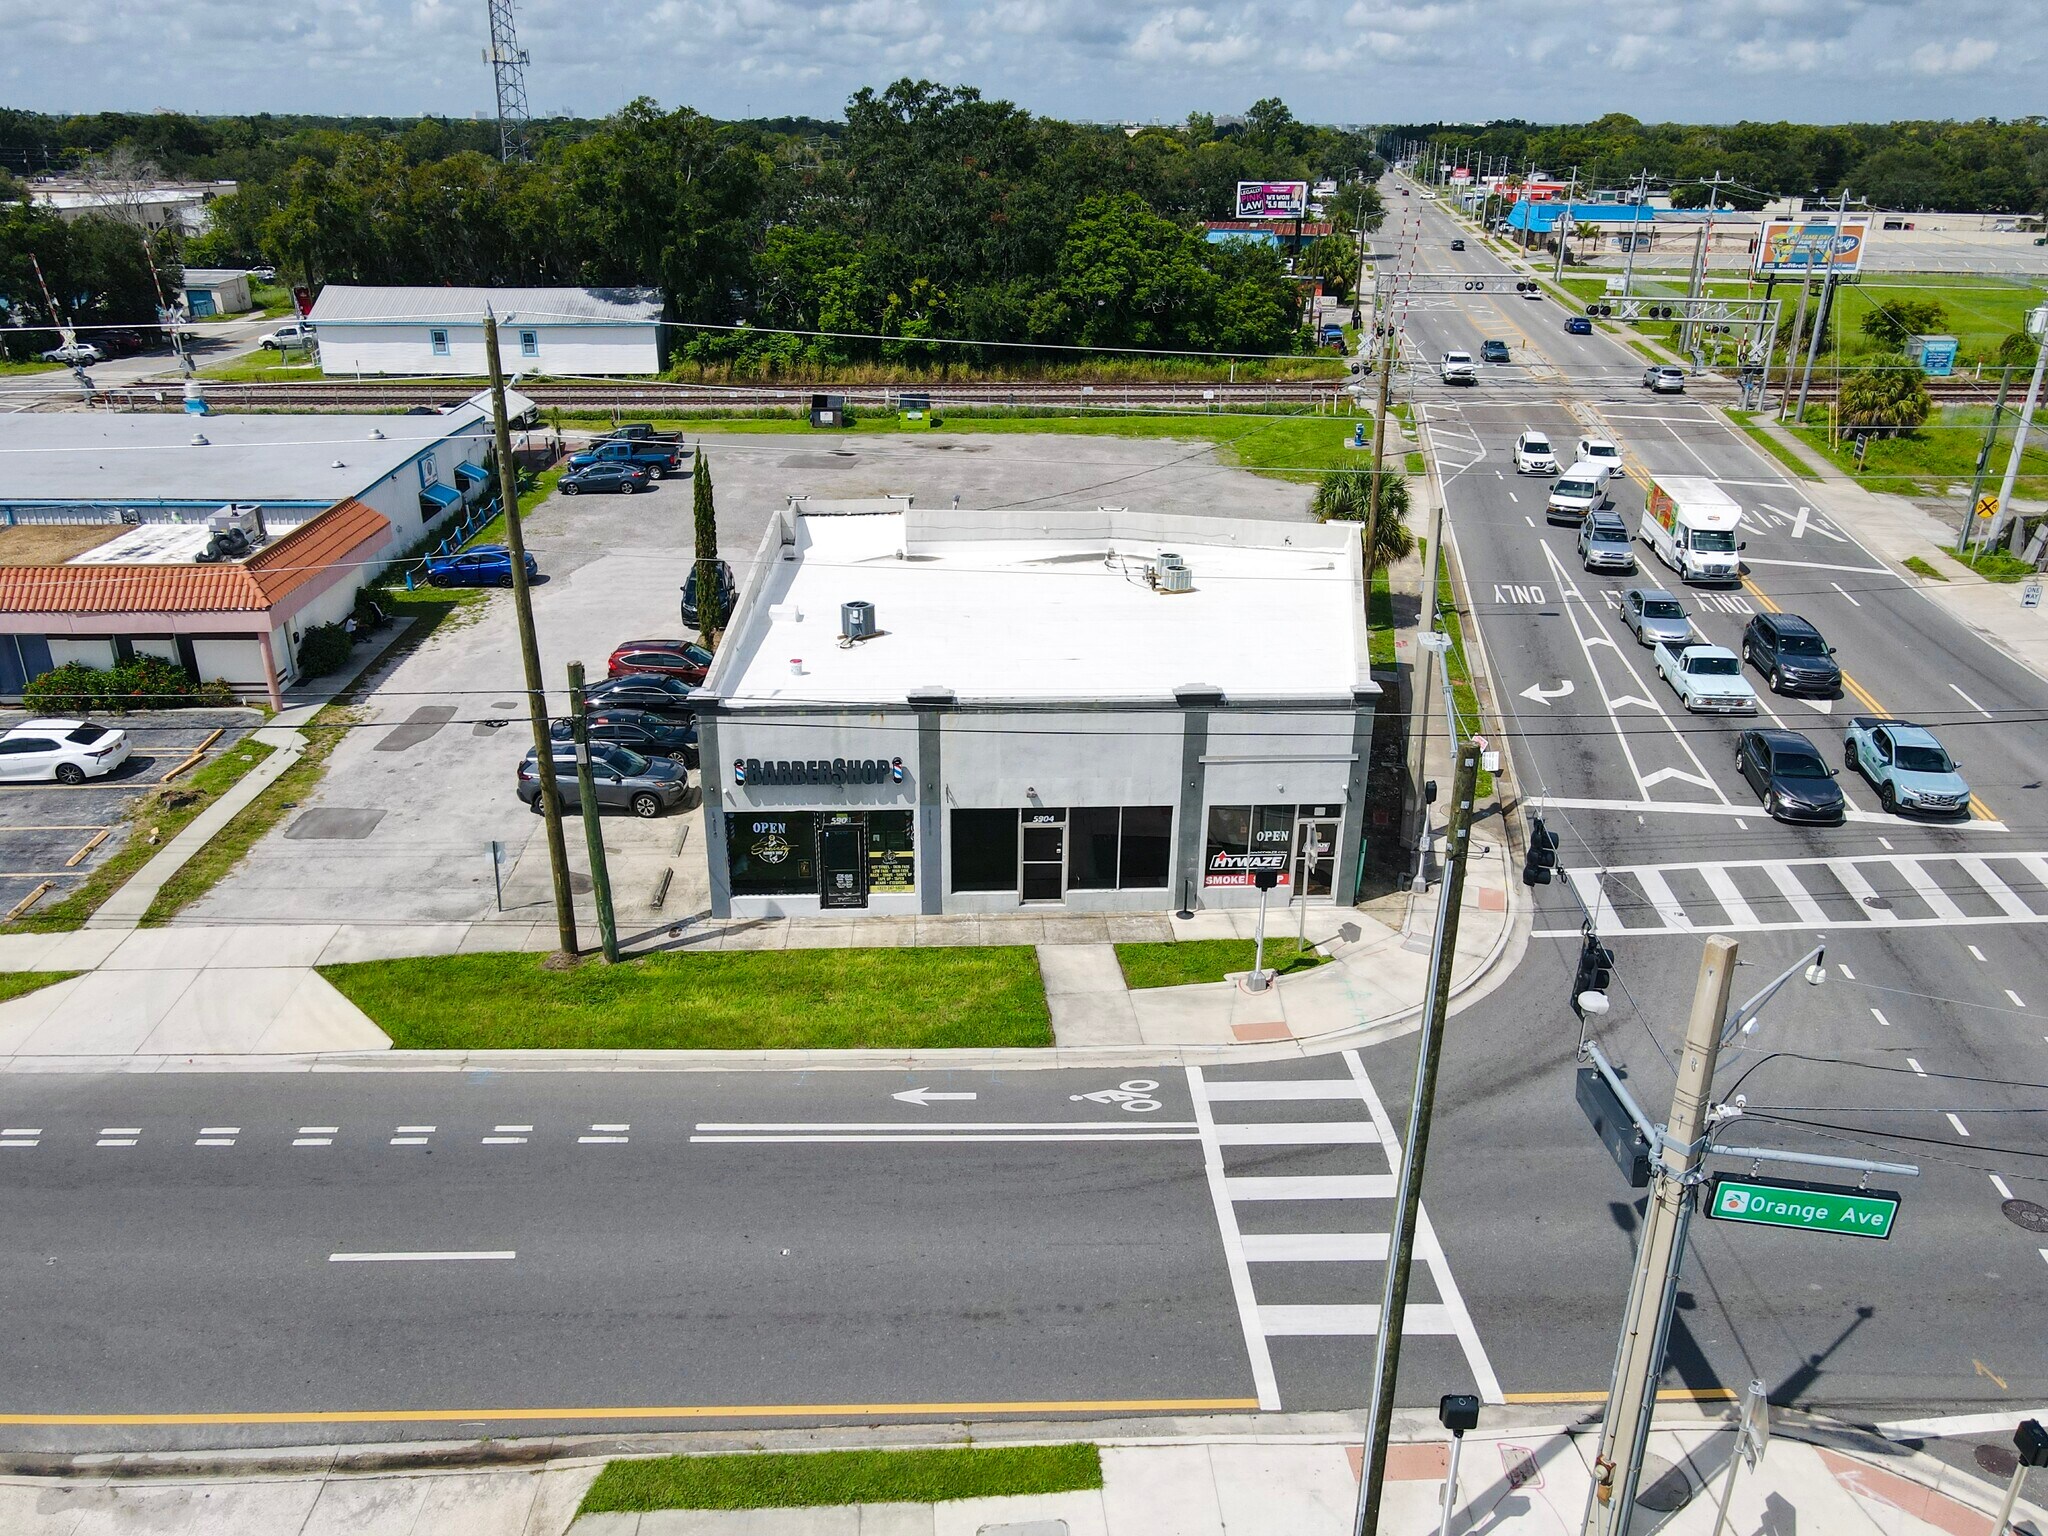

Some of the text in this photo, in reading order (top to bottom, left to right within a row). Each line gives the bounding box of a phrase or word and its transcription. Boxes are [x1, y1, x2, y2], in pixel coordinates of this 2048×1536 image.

[1242, 194, 1263, 202] PINK
[1241, 201, 1262, 211] LAW
[1494, 584, 1546, 604] ONLY
[1691, 592, 1755, 615] ONLY
[1032, 815, 1055, 823] 5904
[752, 822, 787, 834] OPEN
[1256, 830, 1290, 842] OPEN
[1214, 857, 1283, 868] HYWAZE
[1205, 875, 1246, 885] SMOKE
[1750, 1196, 1884, 1226] Orange Ave
